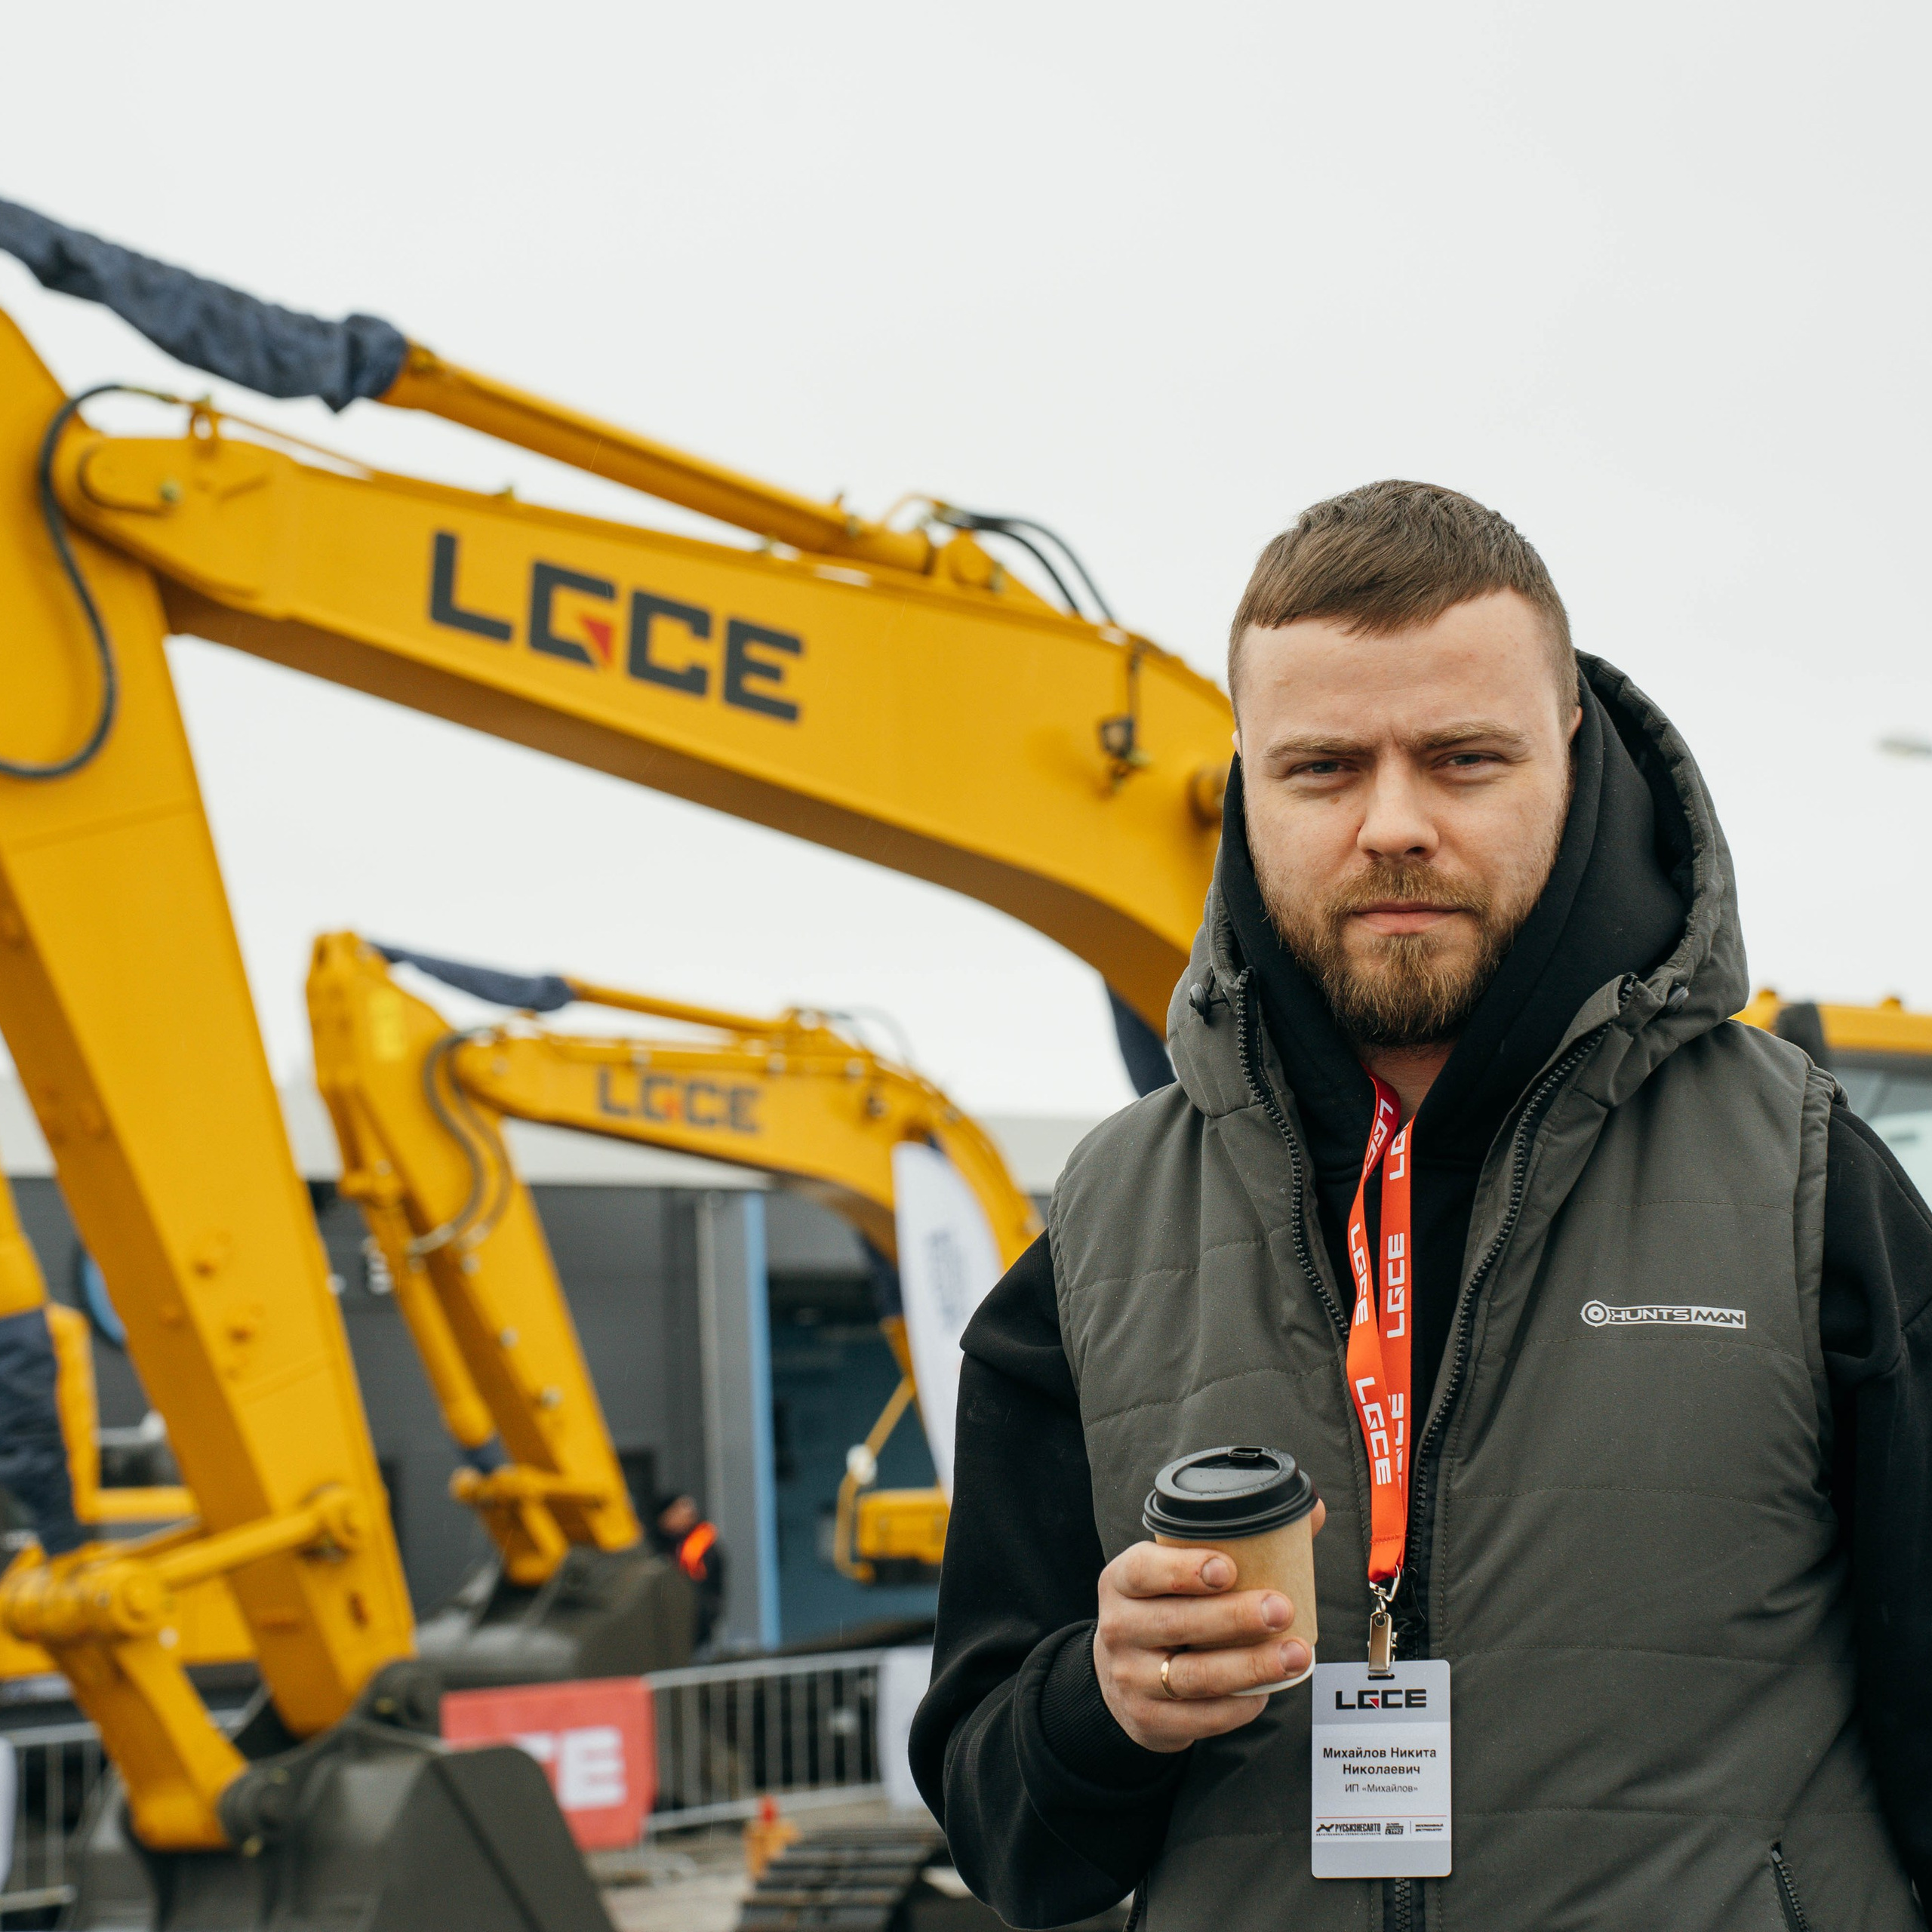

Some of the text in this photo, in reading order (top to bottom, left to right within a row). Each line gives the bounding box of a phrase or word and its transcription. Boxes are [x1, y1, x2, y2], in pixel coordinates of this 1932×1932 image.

[429, 531, 803, 723] LGCE
[1386, 1232, 1405, 1338] LGCE
[1355, 1377, 1392, 1485] LGCE
[1335, 1689, 1427, 1710] LGCE
[1323, 1746, 1437, 1758] Михайлов Никита
[1343, 1764, 1420, 1775] Николаевич
[1345, 1783, 1418, 1793] ИП «Михайлов»
